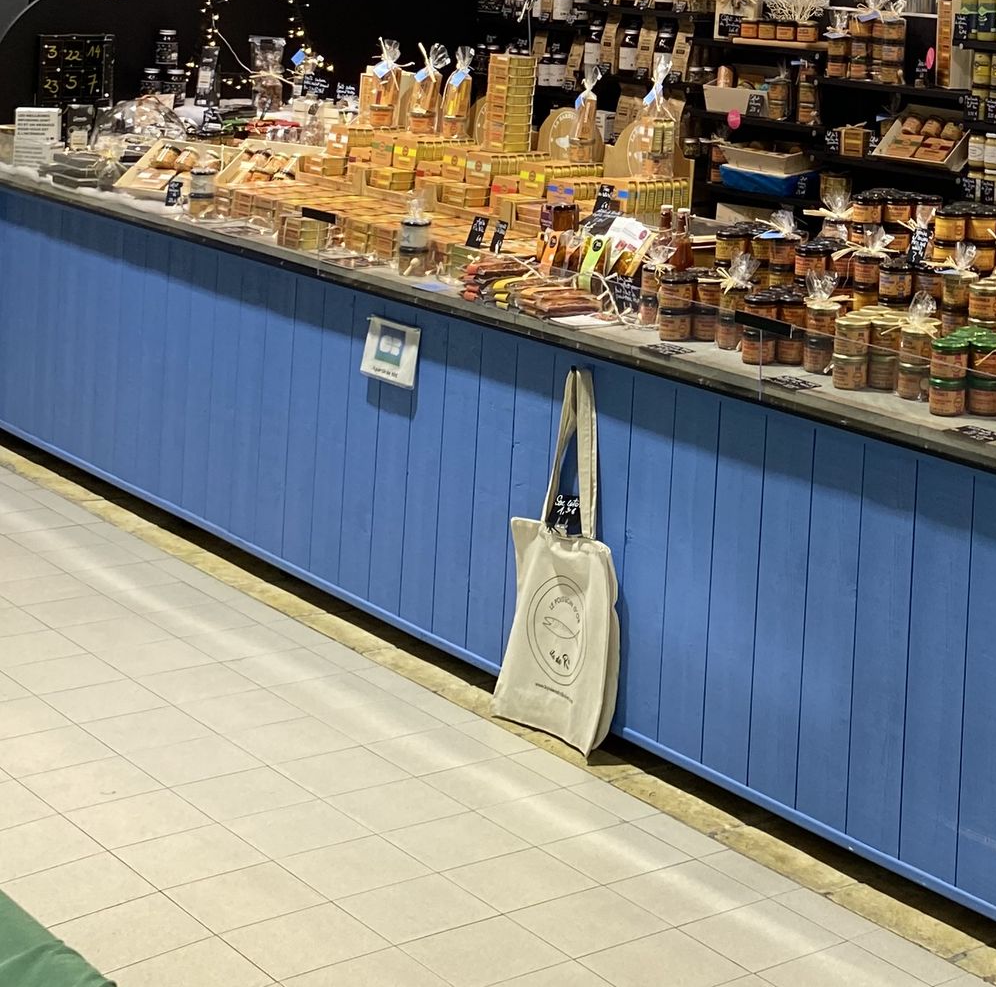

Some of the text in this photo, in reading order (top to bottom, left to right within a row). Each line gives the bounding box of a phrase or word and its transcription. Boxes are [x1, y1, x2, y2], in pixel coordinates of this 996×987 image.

[48, 45, 101, 61] 3 22 14
[44, 74, 98, 95] 23 5 7
